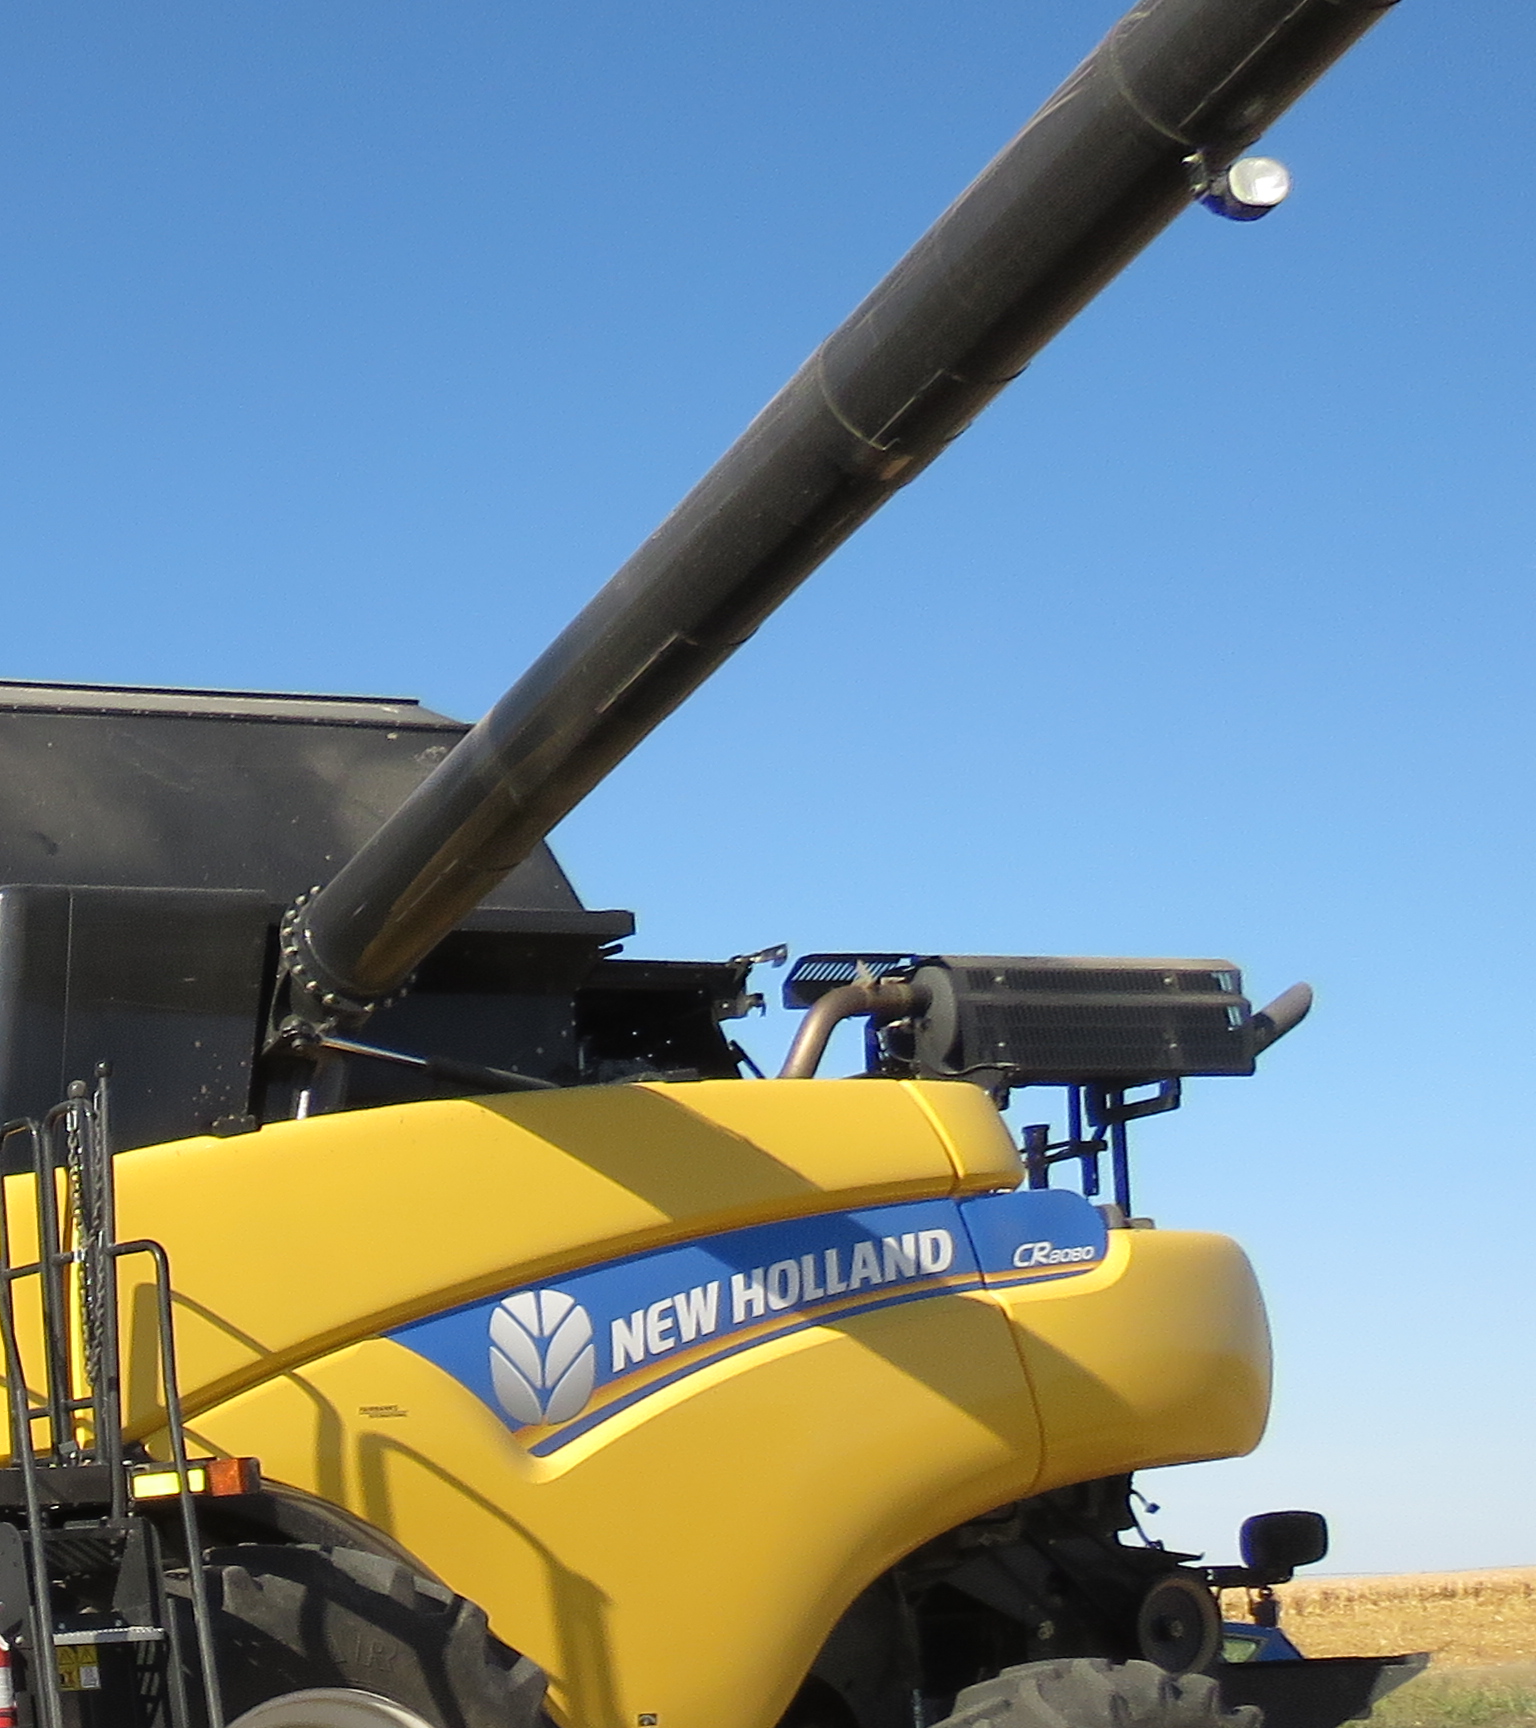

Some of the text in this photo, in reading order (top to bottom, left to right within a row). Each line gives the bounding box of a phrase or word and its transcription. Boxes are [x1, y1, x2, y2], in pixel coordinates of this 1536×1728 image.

[1013, 1241, 1095, 1268] CR8080
[609, 1227, 955, 1373] NEW HOLLAND
